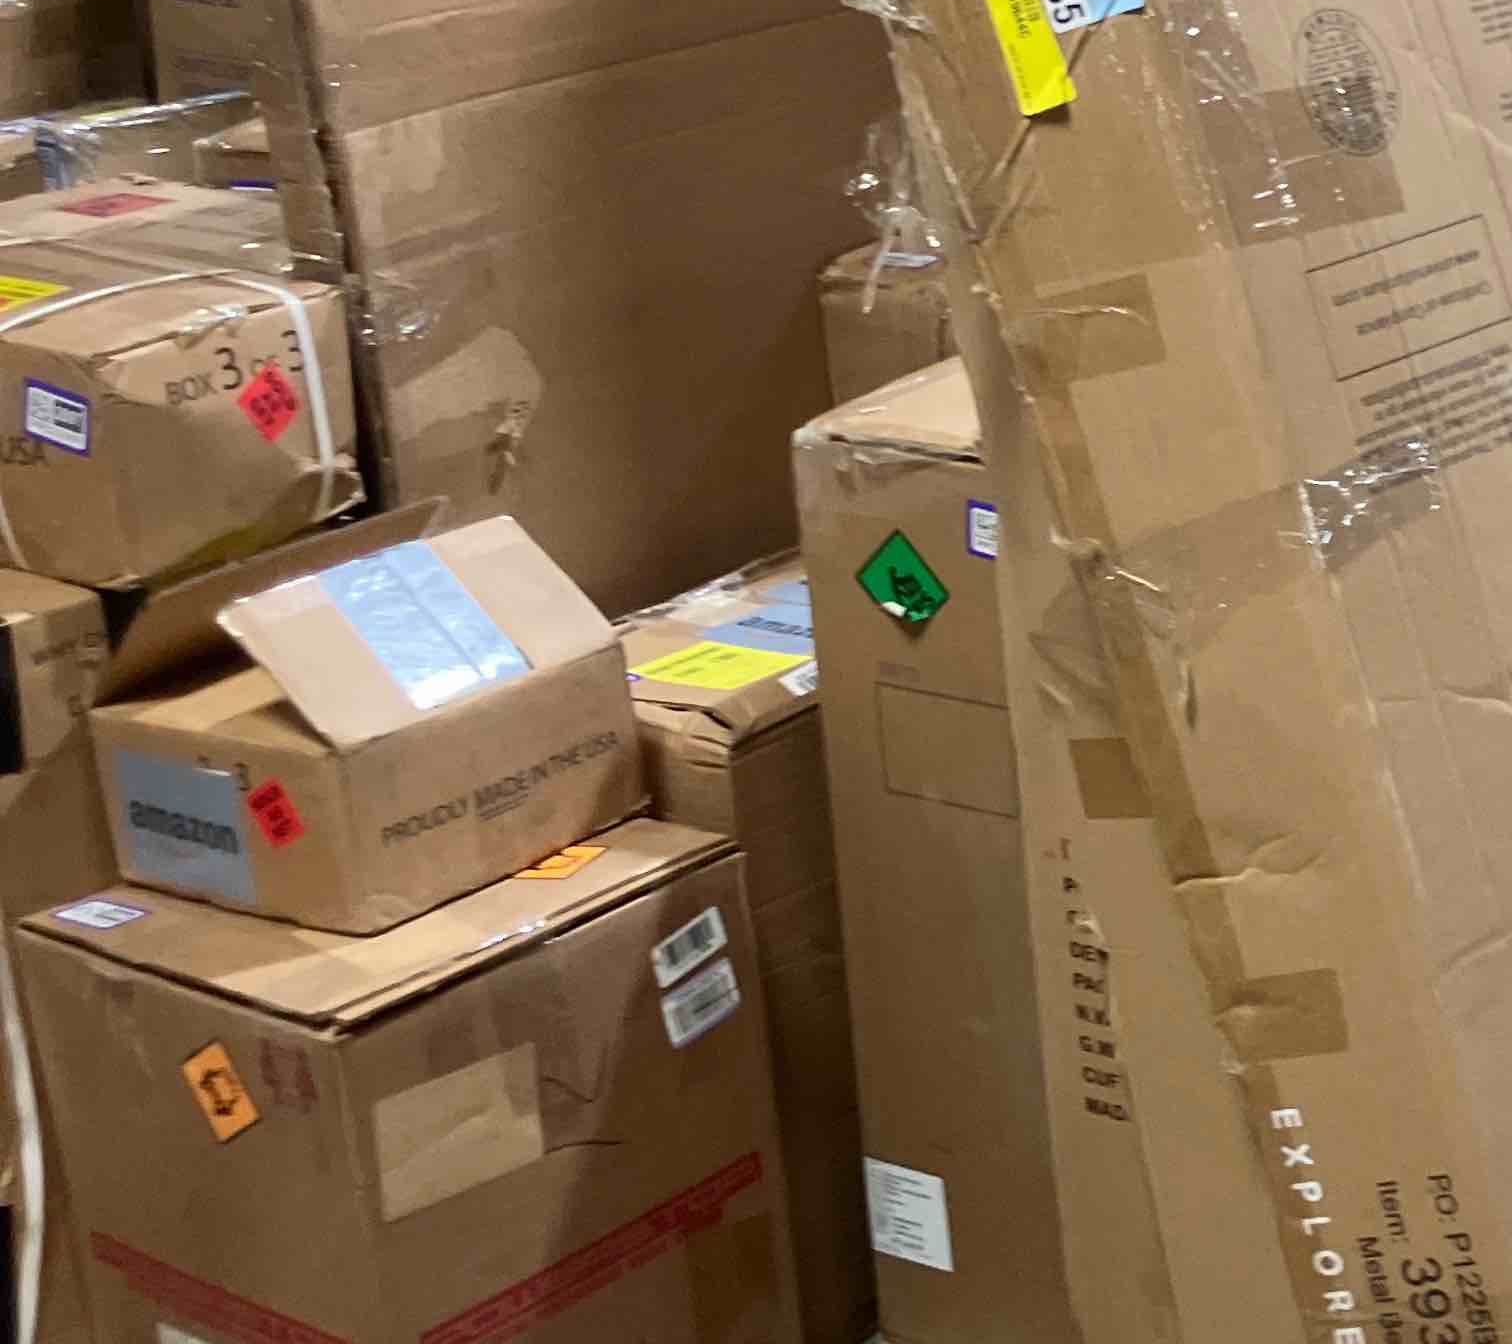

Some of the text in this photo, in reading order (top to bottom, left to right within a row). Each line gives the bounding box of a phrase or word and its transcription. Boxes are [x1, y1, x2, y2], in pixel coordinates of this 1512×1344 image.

[164, 372, 217, 406] BOX
[213, 346, 243, 390] 3
[380, 797, 468, 847] PROUDLY
[474, 774, 531, 810] MADE
[582, 730, 619, 762] USA
[128, 799, 239, 856] amazon
[1375, 1179, 1409, 1244] Item:
[1427, 1173, 1459, 1223] PO:
[1356, 1235, 1397, 1305] Metal
